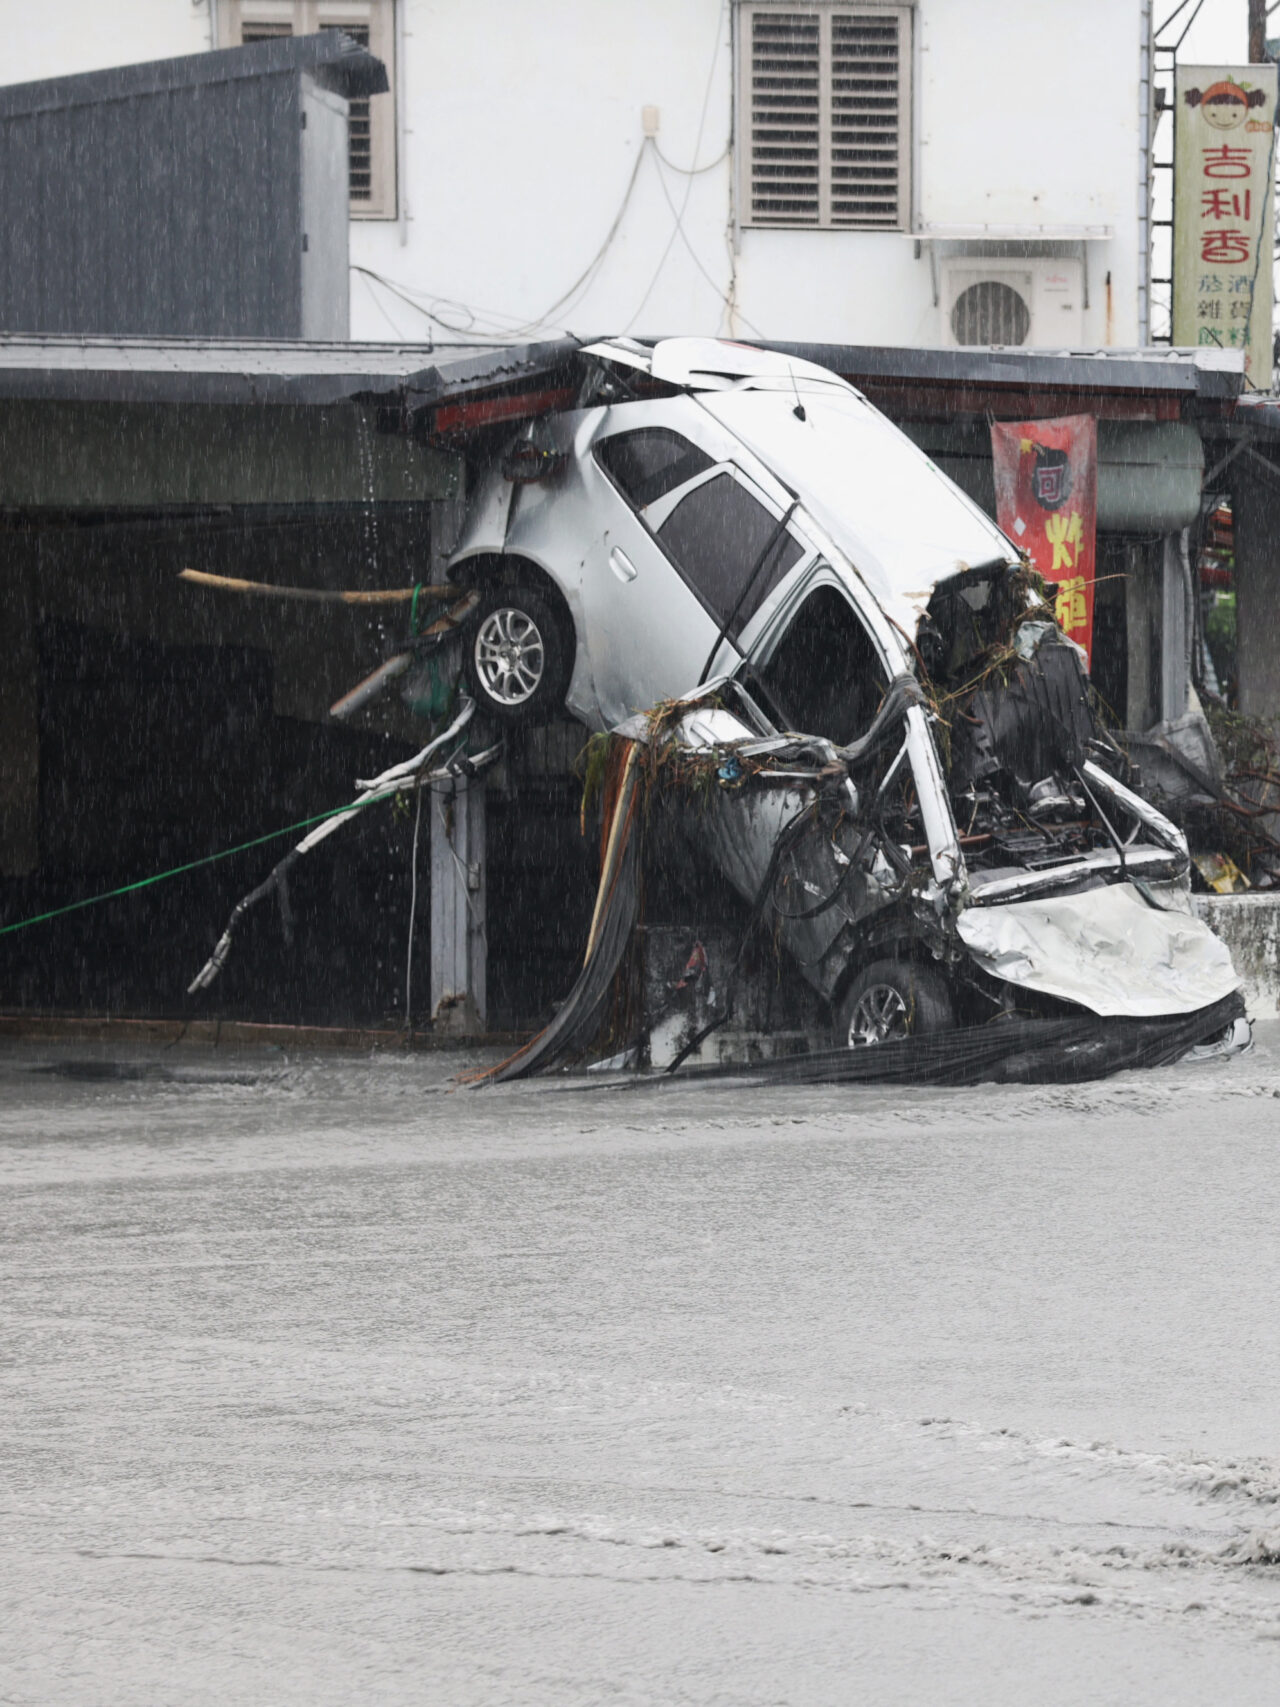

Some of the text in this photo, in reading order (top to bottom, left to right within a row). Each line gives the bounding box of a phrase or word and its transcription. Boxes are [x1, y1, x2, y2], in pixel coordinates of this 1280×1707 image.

[1200, 144, 1252, 264] 吉利香
[1038, 465, 1063, 503] 可
[1045, 511, 1088, 650] 炸彈
